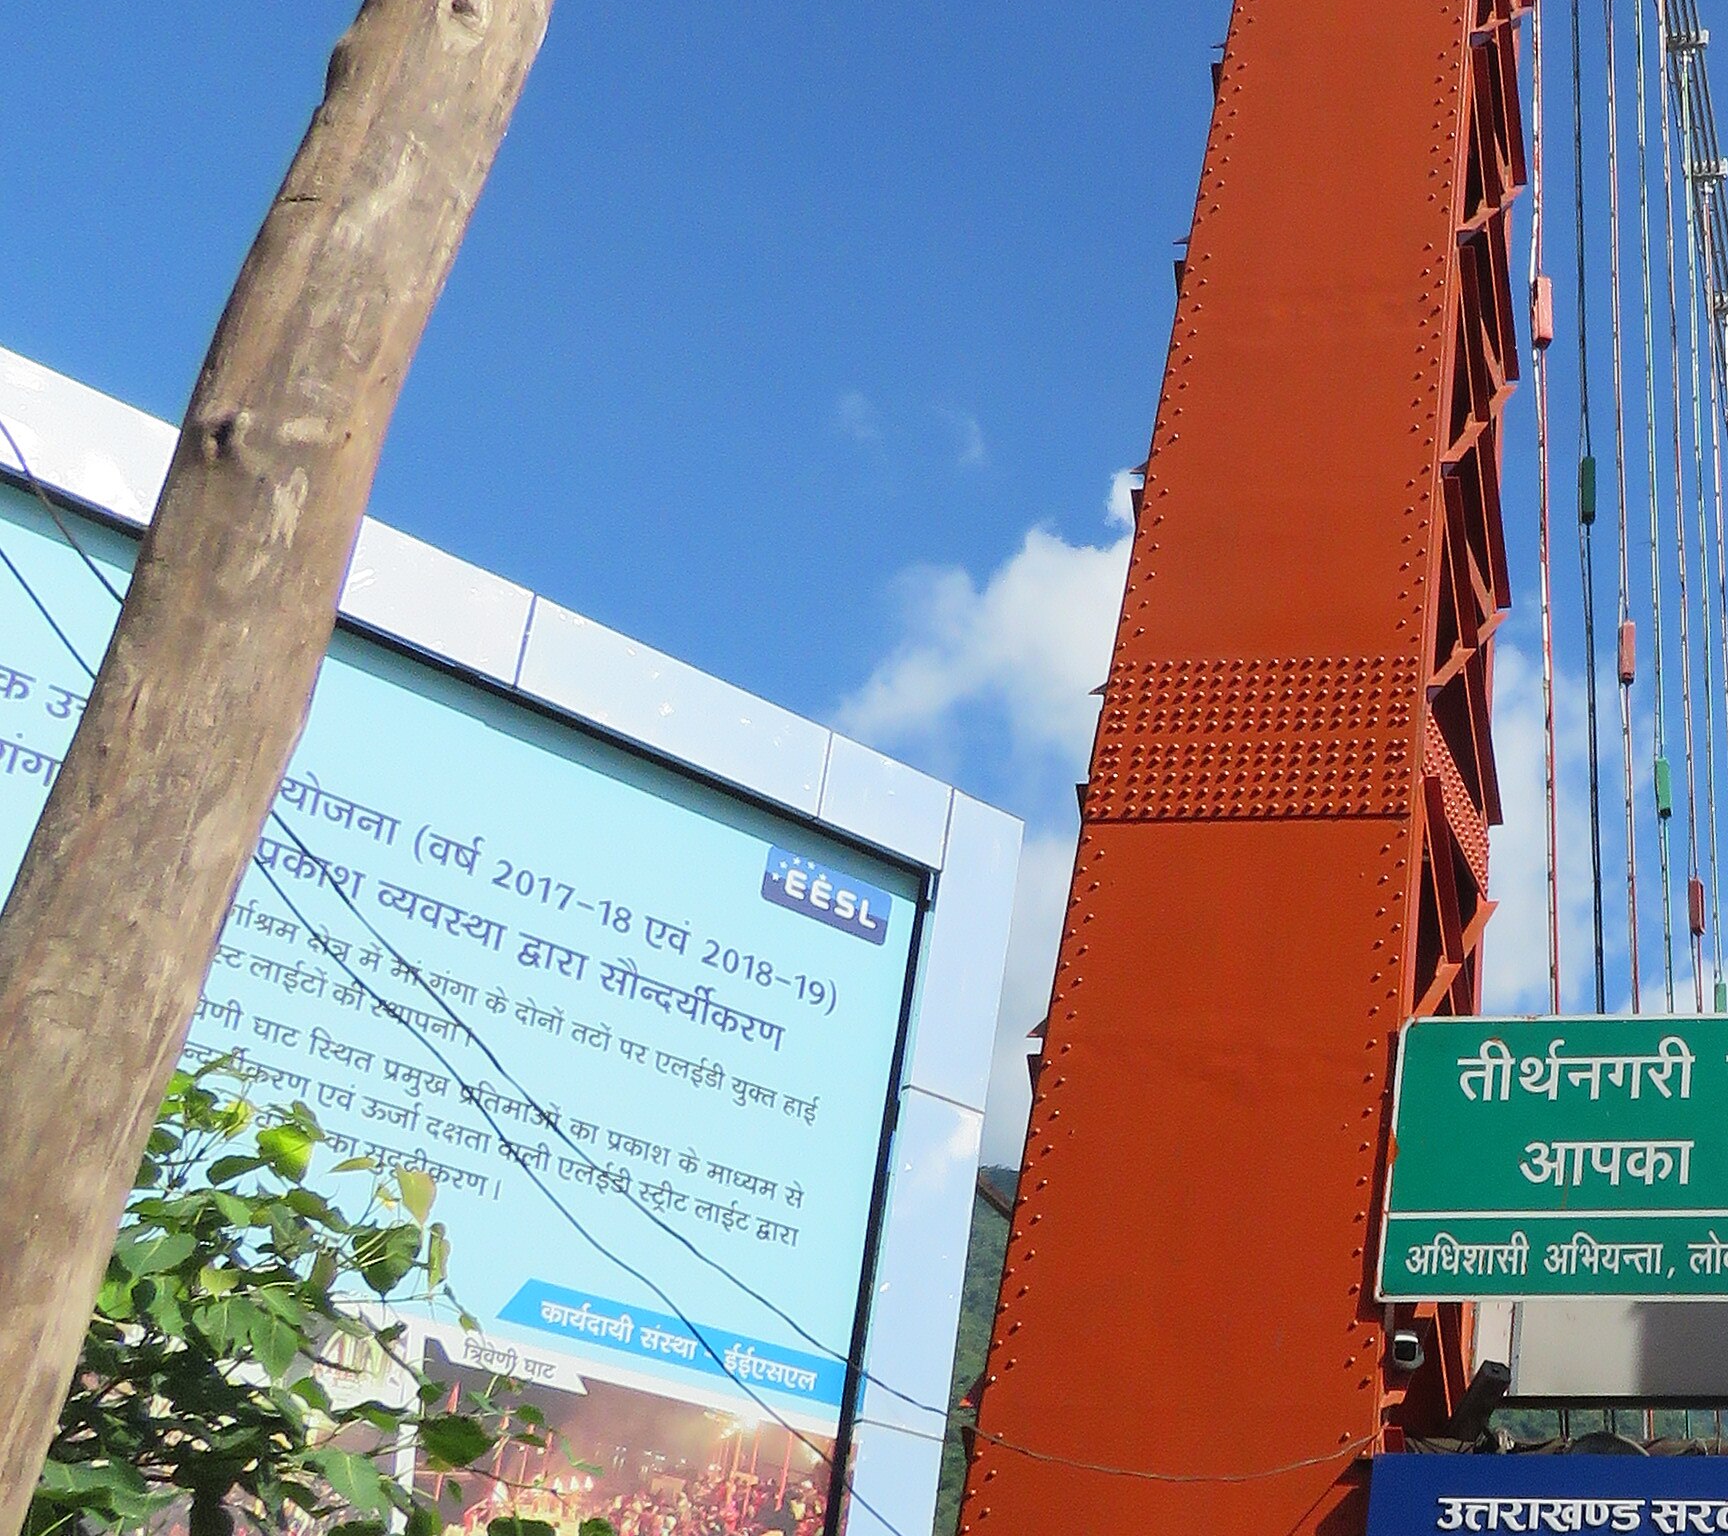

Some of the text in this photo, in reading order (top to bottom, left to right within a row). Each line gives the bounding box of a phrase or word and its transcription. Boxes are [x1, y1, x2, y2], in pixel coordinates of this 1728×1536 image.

[414, 824, 485, 876] (वर्ष
[644, 916, 692, 955] एवं
[785, 869, 877, 929] EESL
[257, 837, 786, 1052] प्रकाश व्यवस्था द्वारा सौन्दर्यीकरण
[359, 942, 383, 972] में
[429, 970, 478, 1005] गंगा
[485, 986, 507, 1014] के
[514, 996, 565, 1036] दोनों
[571, 1022, 613, 1053] तटों
[620, 1037, 650, 1065] पर
[655, 1050, 725, 1092] एलईडी
[731, 1076, 778, 1109] युक्त
[783, 1093, 820, 1125] हाई
[1457, 1036, 1696, 1101] तीर्थनगरी
[252, 1015, 301, 1047] घाट
[310, 1026, 376, 1073] स्थित
[383, 1057, 451, 1098] प्रमुख
[569, 1117, 601, 1144] का
[607, 1128, 672, 1167] प्रकाश
[678, 1146, 700, 1175] के
[706, 1160, 778, 1201] माध्यम
[785, 1180, 804, 1210] से
[324, 1129, 360, 1158] का
[318, 1082, 356, 1112] एवं
[361, 1094, 421, 1132] ऊर्जा
[426, 1116, 492, 1154] दक्षता
[556, 1161, 633, 1197] एलईडी
[694, 1200, 752, 1233] लाईट
[755, 1216, 799, 1248] द्वारा
[1519, 1140, 1694, 1185] आपका
[1405, 1231, 1530, 1276] अधिशासी
[1543, 1231, 1675, 1279] अभियन्ता,
[522, 1354, 558, 1381] घाट
[540, 1299, 634, 1345] कार्यदायी
[639, 1324, 698, 1360] संस्था
[724, 1341, 818, 1392] ईईएसएल
[1437, 1497, 1646, 1532] उत्तराखण्ड
